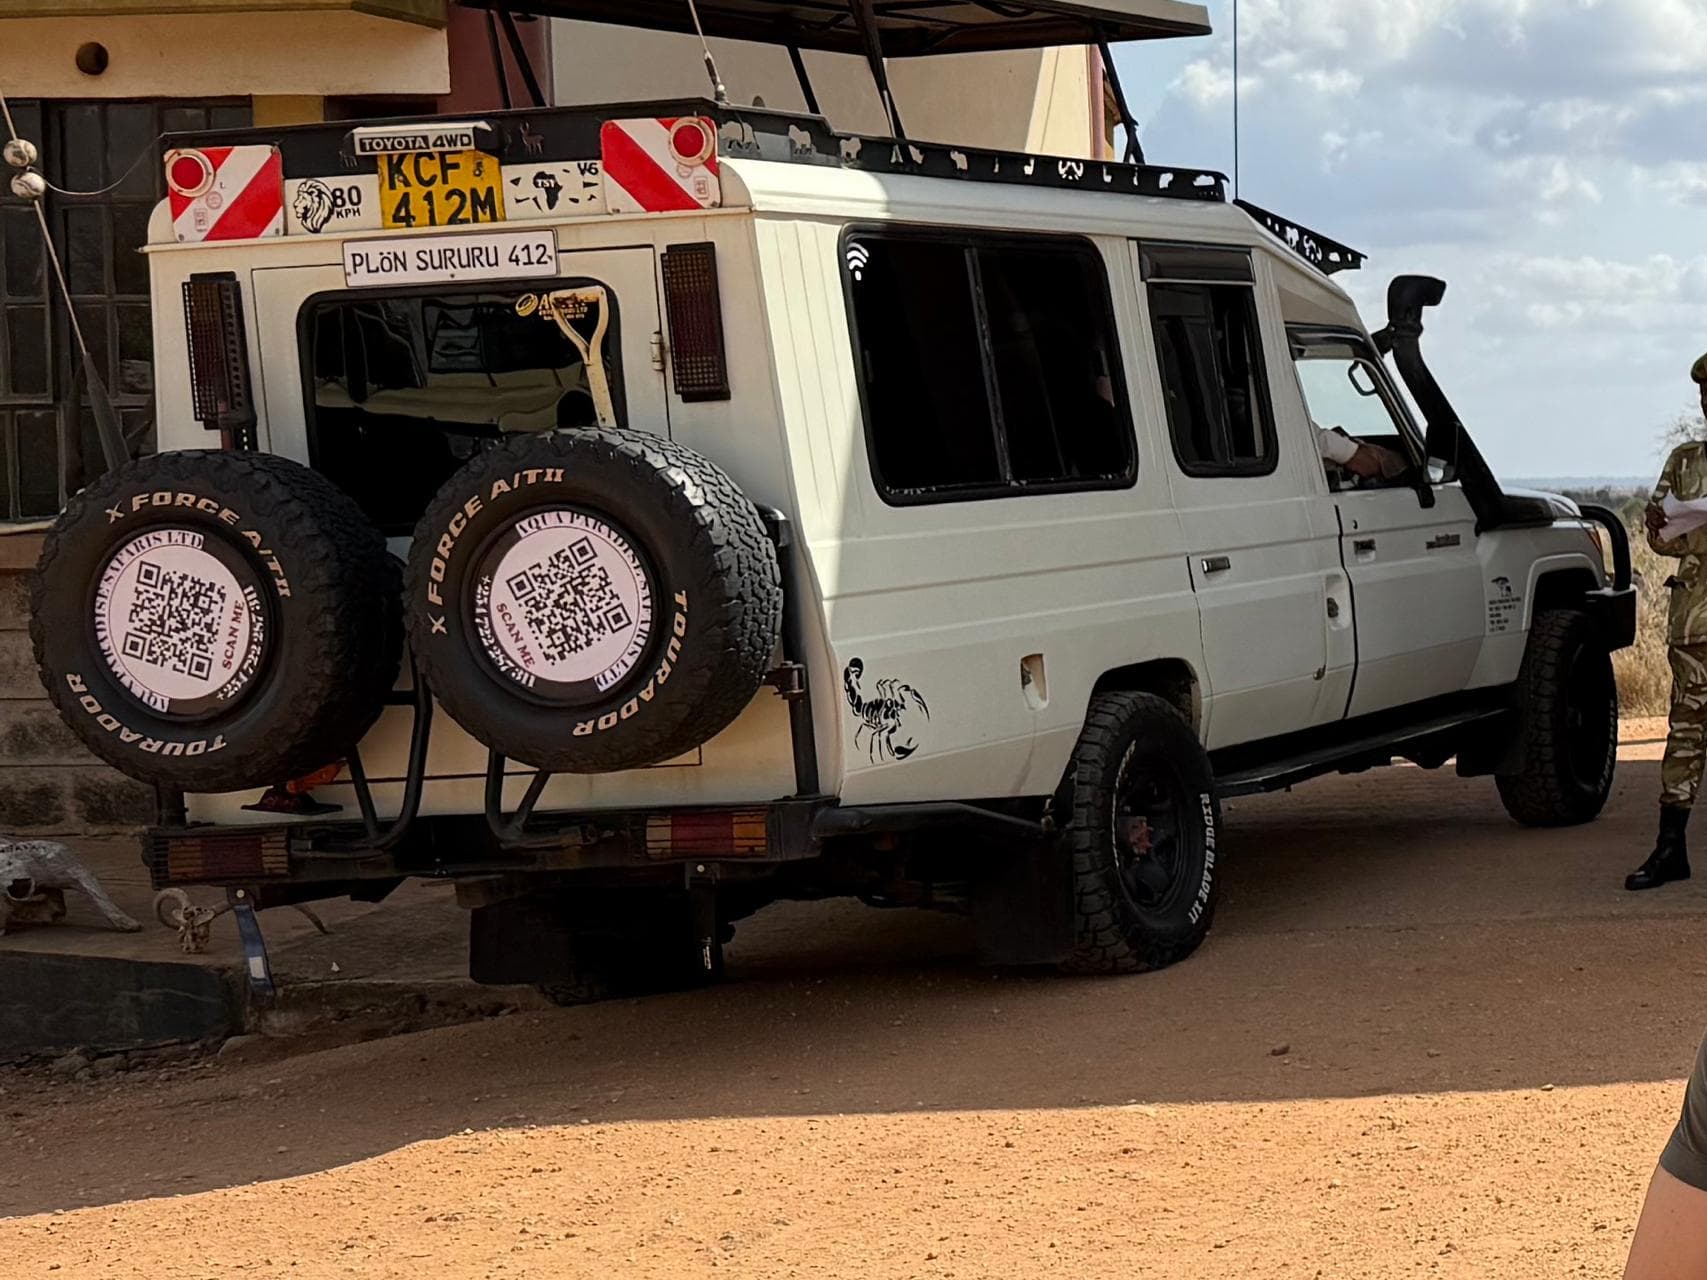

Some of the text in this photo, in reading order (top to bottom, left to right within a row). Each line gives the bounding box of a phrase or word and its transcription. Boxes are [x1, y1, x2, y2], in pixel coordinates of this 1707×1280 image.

[361, 134, 472, 151] TOYOTA 4WD
[387, 151, 461, 190] KCF
[577, 162, 599, 176] V6
[333, 186, 362, 207] 80
[335, 208, 361, 219] KPH
[392, 187, 498, 227] 412M
[416, 246, 499, 271] SURURU
[508, 244, 548, 267] 412
[105, 501, 125, 523] X
[131, 492, 241, 525] FORCE
[168, 531, 204, 548] LTD
[428, 494, 484, 606] FORCE
[222, 600, 246, 670] SCAN ME
[427, 612, 447, 634] X
[496, 602, 535, 668] SCAN ME
[573, 589, 689, 737] TOURADOR
[65, 672, 228, 757] TOURADOR
[1200, 793, 1215, 848] RIDGE
[1199, 850, 1215, 903] BLADE
